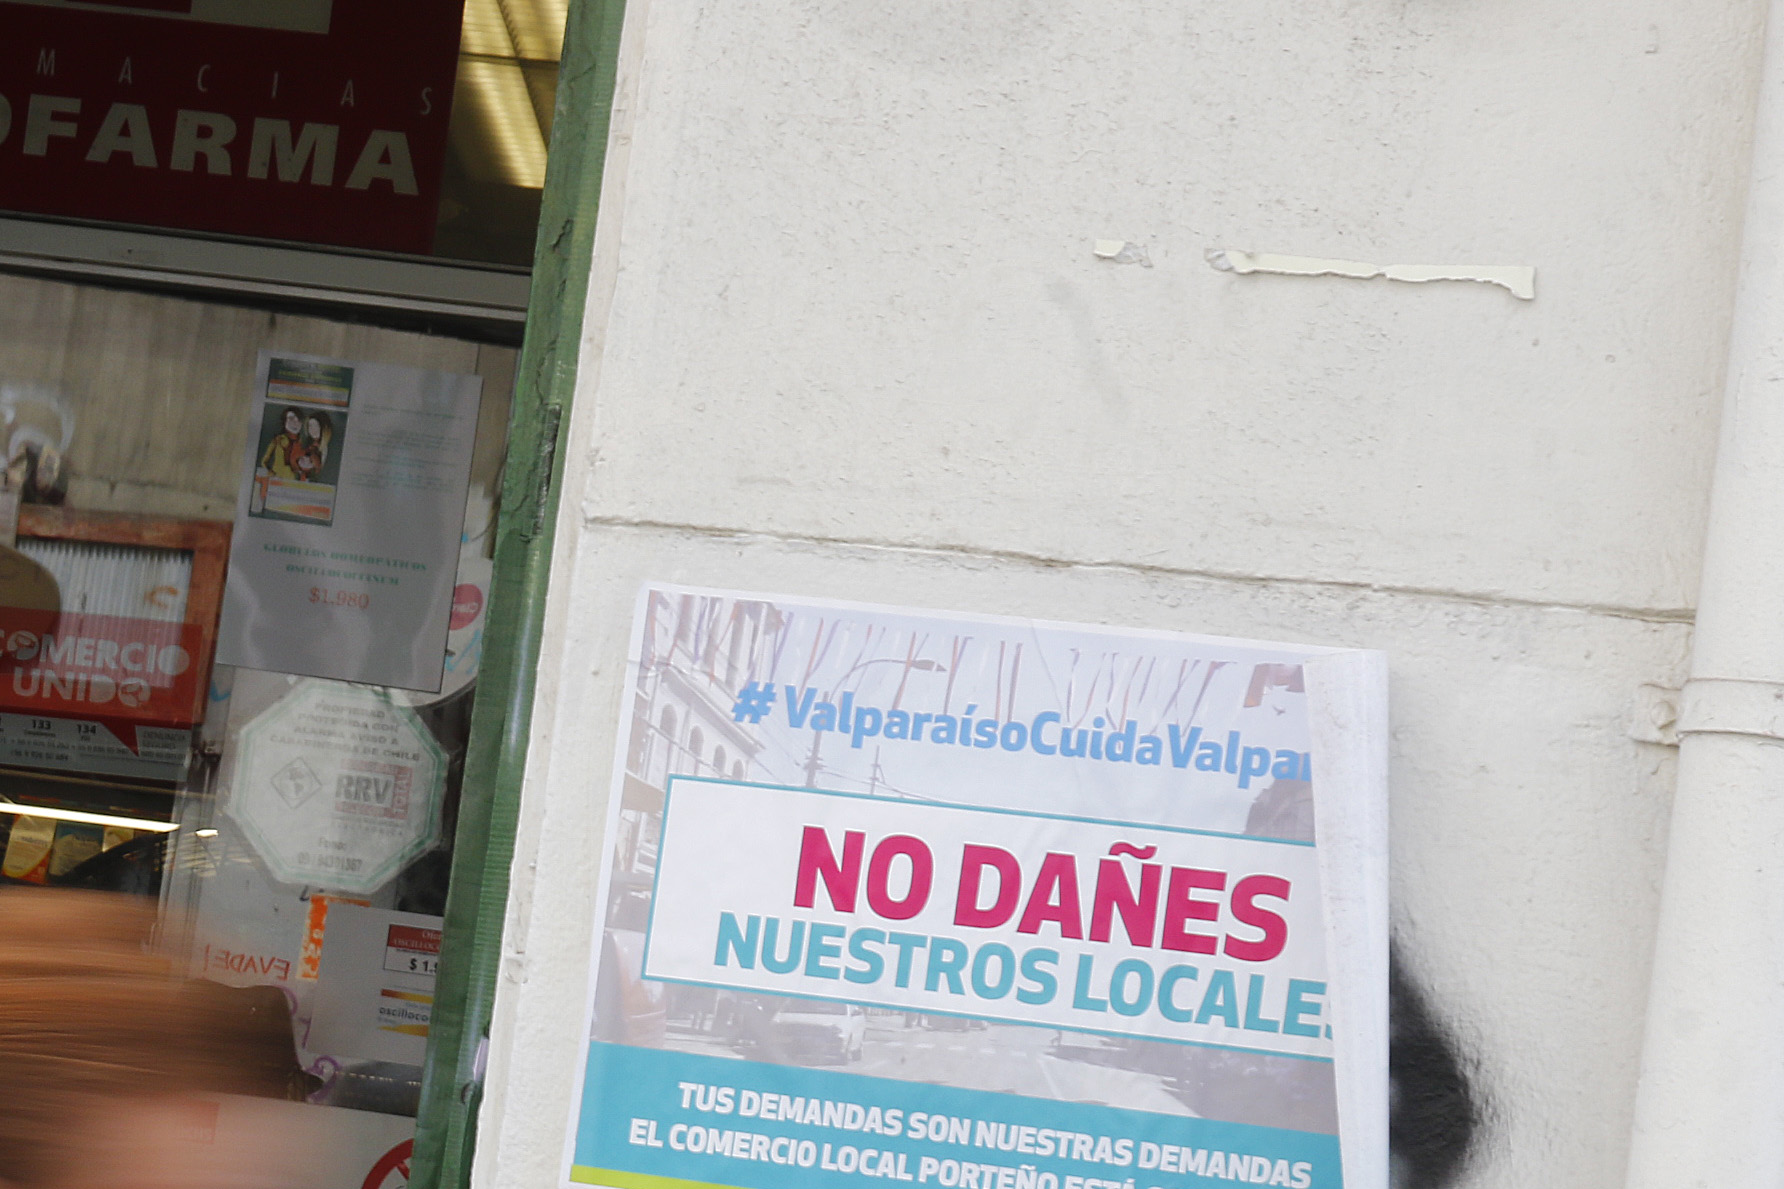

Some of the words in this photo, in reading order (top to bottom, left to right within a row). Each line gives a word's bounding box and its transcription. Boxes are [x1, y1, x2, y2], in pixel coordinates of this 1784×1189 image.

[13, 667, 151, 707] UNIDO
[76, 723, 97, 734] 134
[792, 824, 934, 921] NO
[952, 841, 1293, 962] DAÑES
[713, 911, 1058, 1004] NUESTROS
[1072, 955, 1333, 1040] LOCALE
[629, 1118, 662, 1146] EL
[668, 1123, 817, 1169] COMERCIO
[821, 1143, 912, 1181] LOCAL
[678, 1081, 735, 1116] TUS
[739, 1088, 903, 1136] DEMANDAS
[907, 1111, 969, 1144] SON
[974, 1120, 1133, 1167] NUESTRAS
[1137, 1140, 1313, 1189] DEMANDAS
